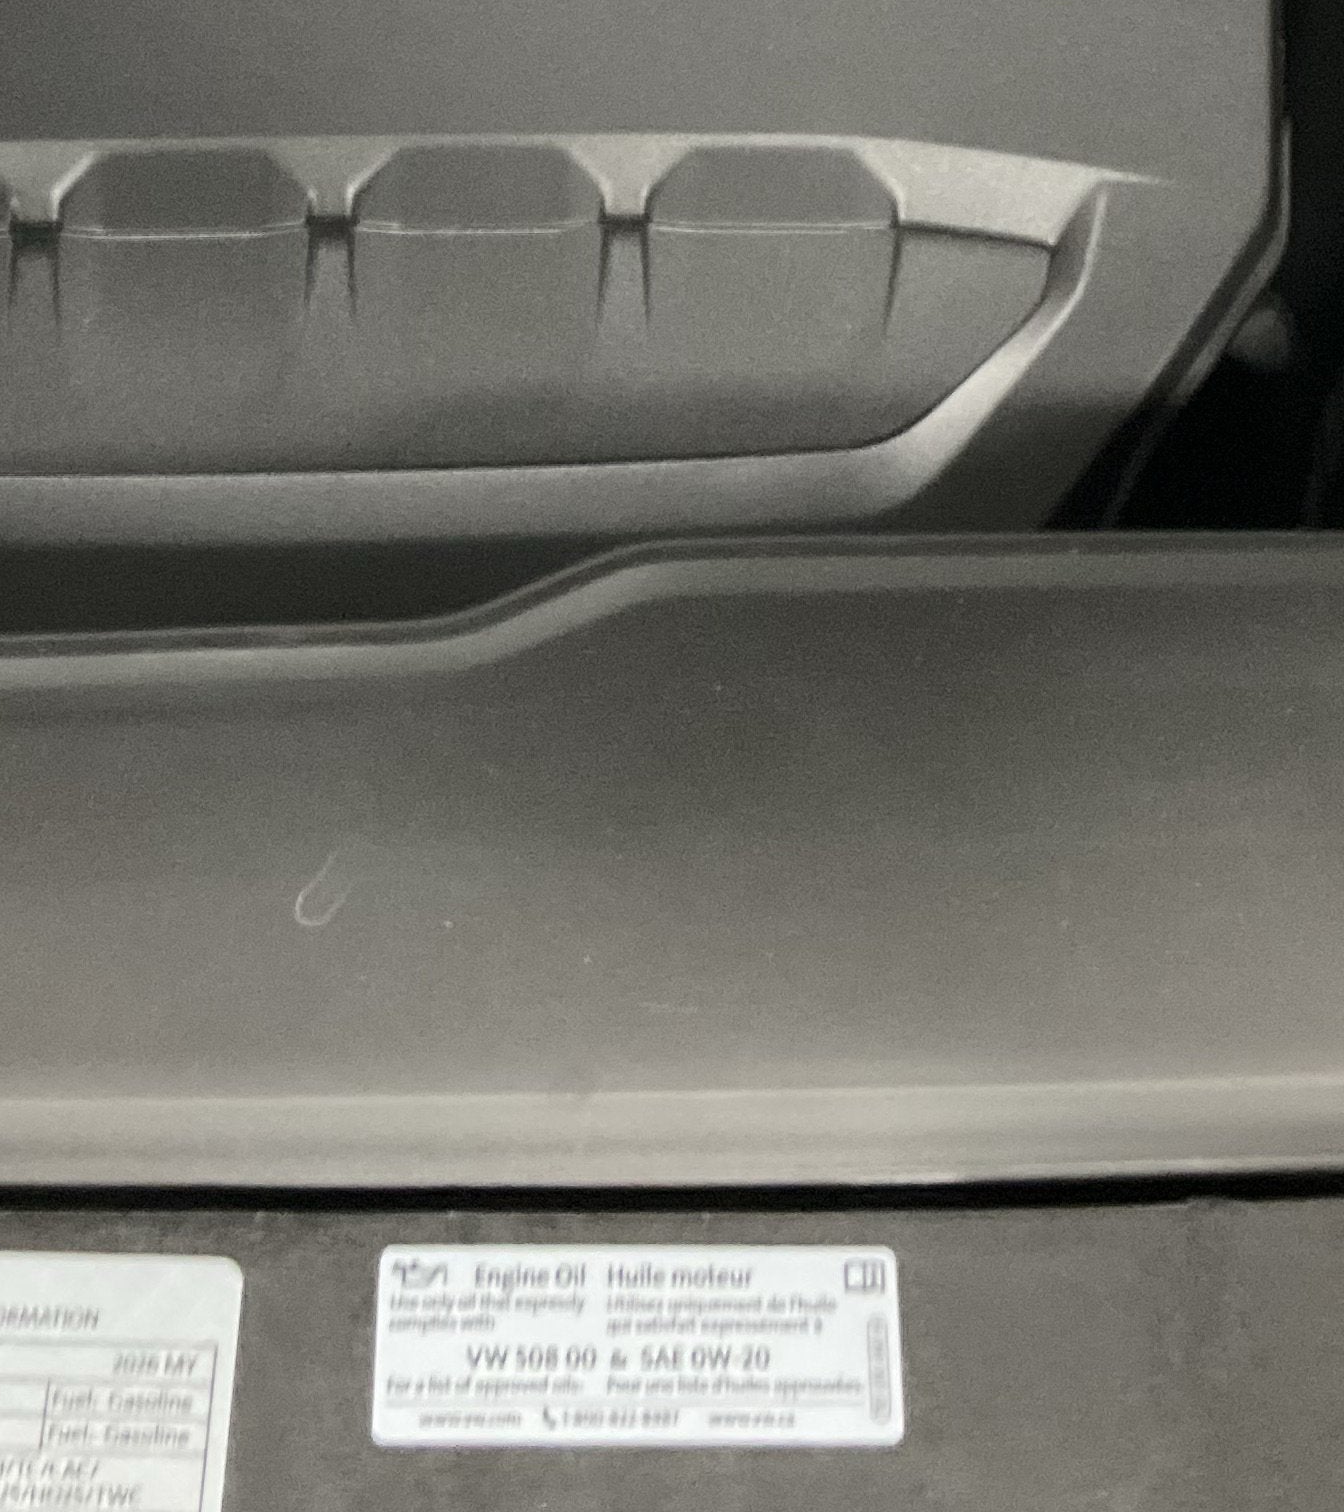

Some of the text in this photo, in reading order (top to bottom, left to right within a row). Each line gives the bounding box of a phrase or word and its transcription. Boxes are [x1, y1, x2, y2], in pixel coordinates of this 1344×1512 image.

[475, 1263, 586, 1296] Engine Oil
[607, 1263, 753, 1289] Huile moteur
[164, 1352, 201, 1377] MY
[466, 1346, 508, 1370] VW
[515, 1346, 558, 1370] 508
[565, 1346, 597, 1370] 00
[640, 1346, 684, 1370] SAE
[108, 1389, 194, 1414] Gasoline
[104, 1423, 192, 1447] Gasoline
